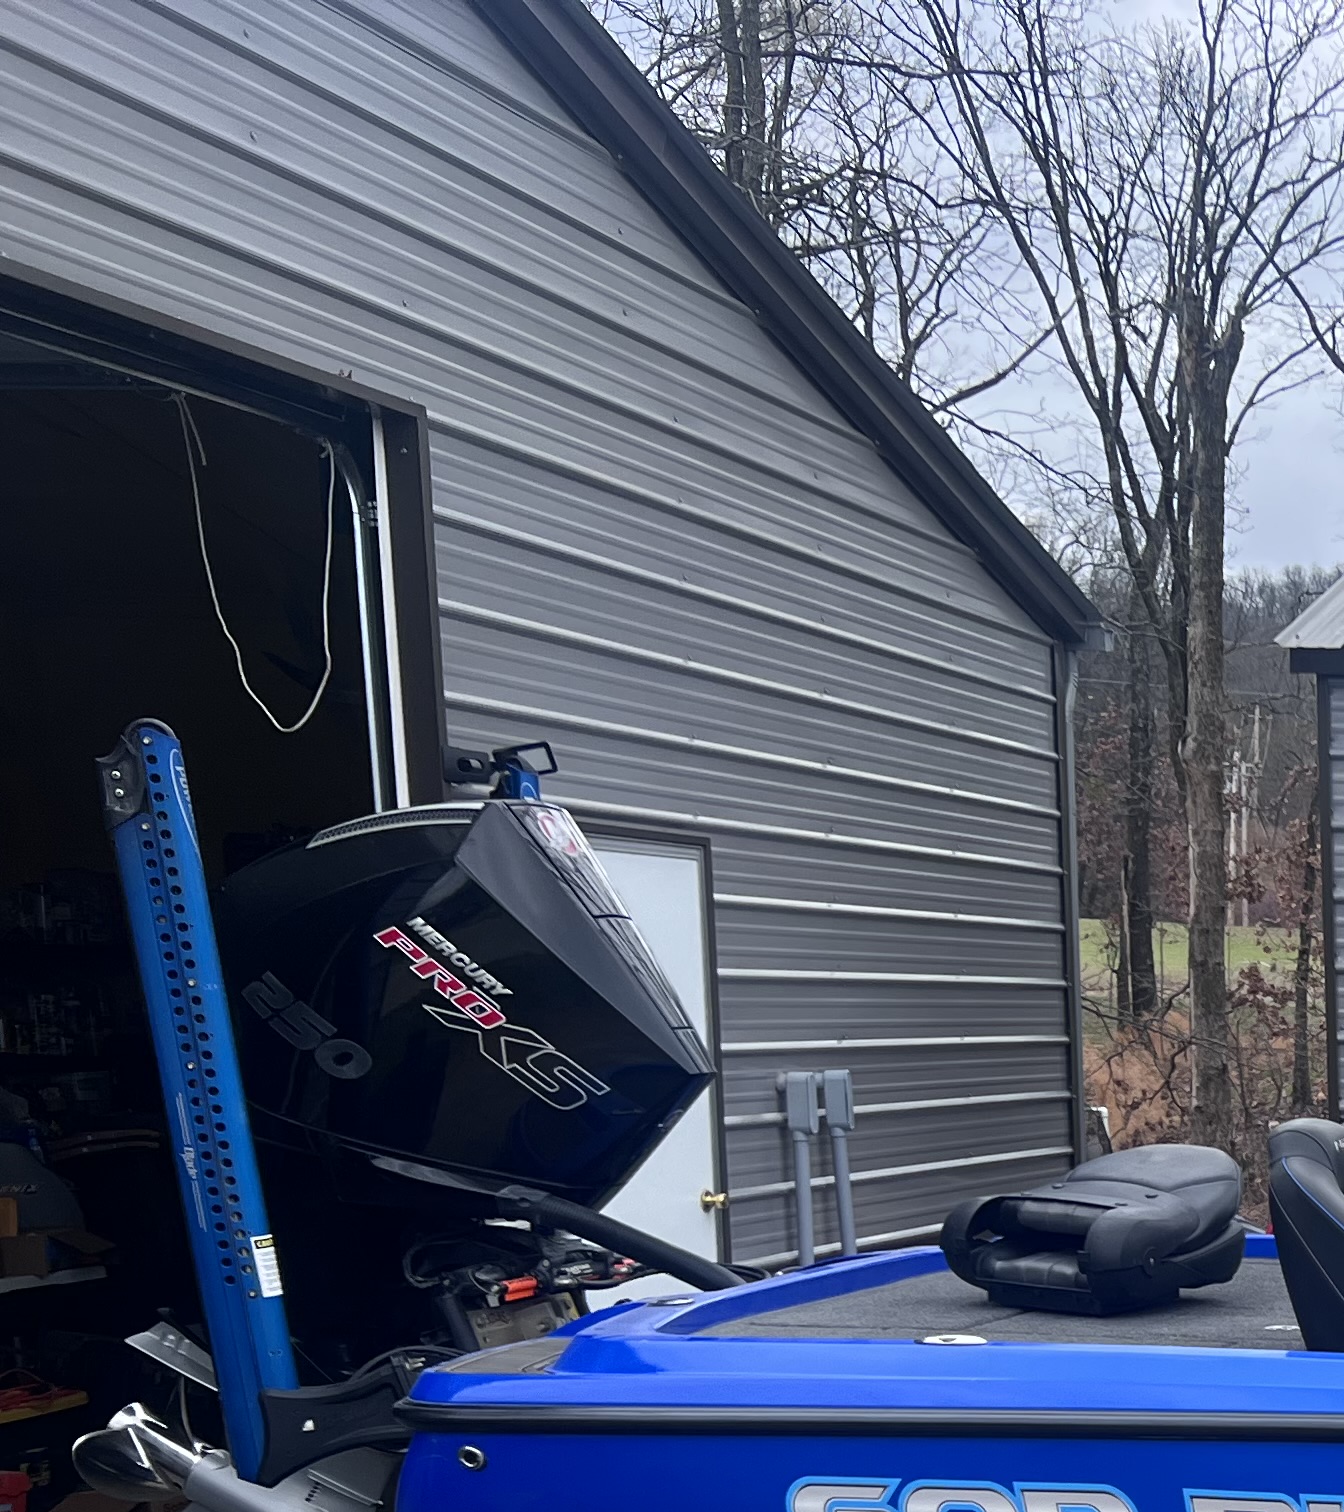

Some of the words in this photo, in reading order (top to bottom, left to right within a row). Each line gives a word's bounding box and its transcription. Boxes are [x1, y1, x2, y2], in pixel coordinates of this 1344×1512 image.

[373, 926, 507, 1030] PRO
[406, 916, 514, 997] MERCURY
[240, 969, 374, 1080] 250
[421, 986, 611, 1111] XS
